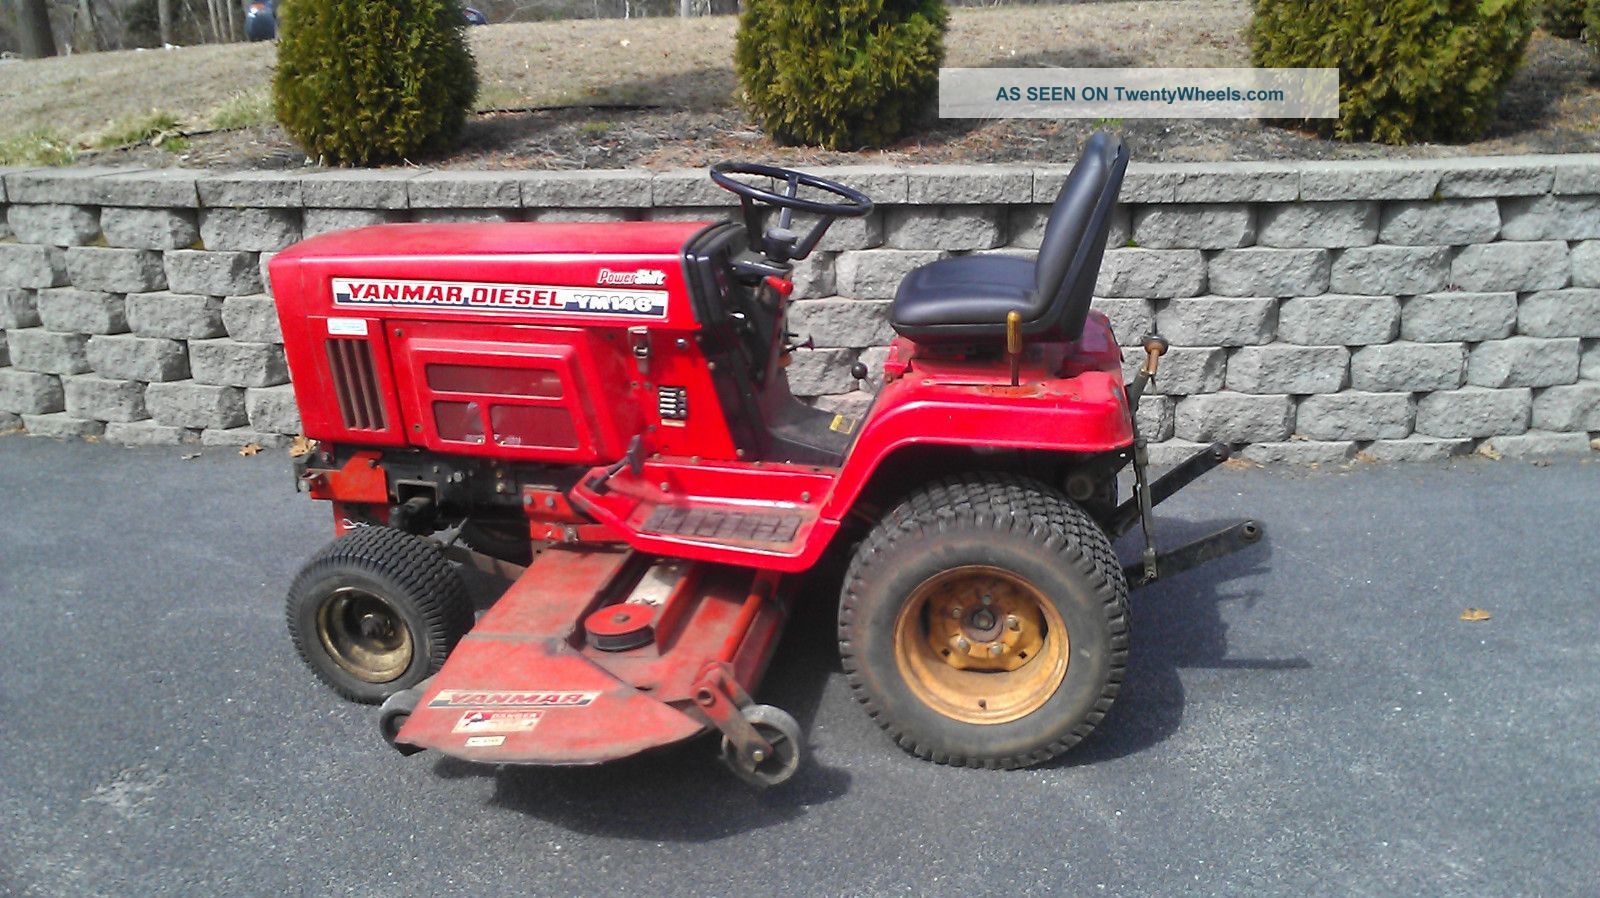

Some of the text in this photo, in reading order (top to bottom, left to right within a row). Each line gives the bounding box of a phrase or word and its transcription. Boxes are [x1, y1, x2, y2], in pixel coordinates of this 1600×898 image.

[348, 283, 462, 302] YANMAR
[471, 286, 563, 307] DIESEL
[448, 692, 585, 705] YANMAR
